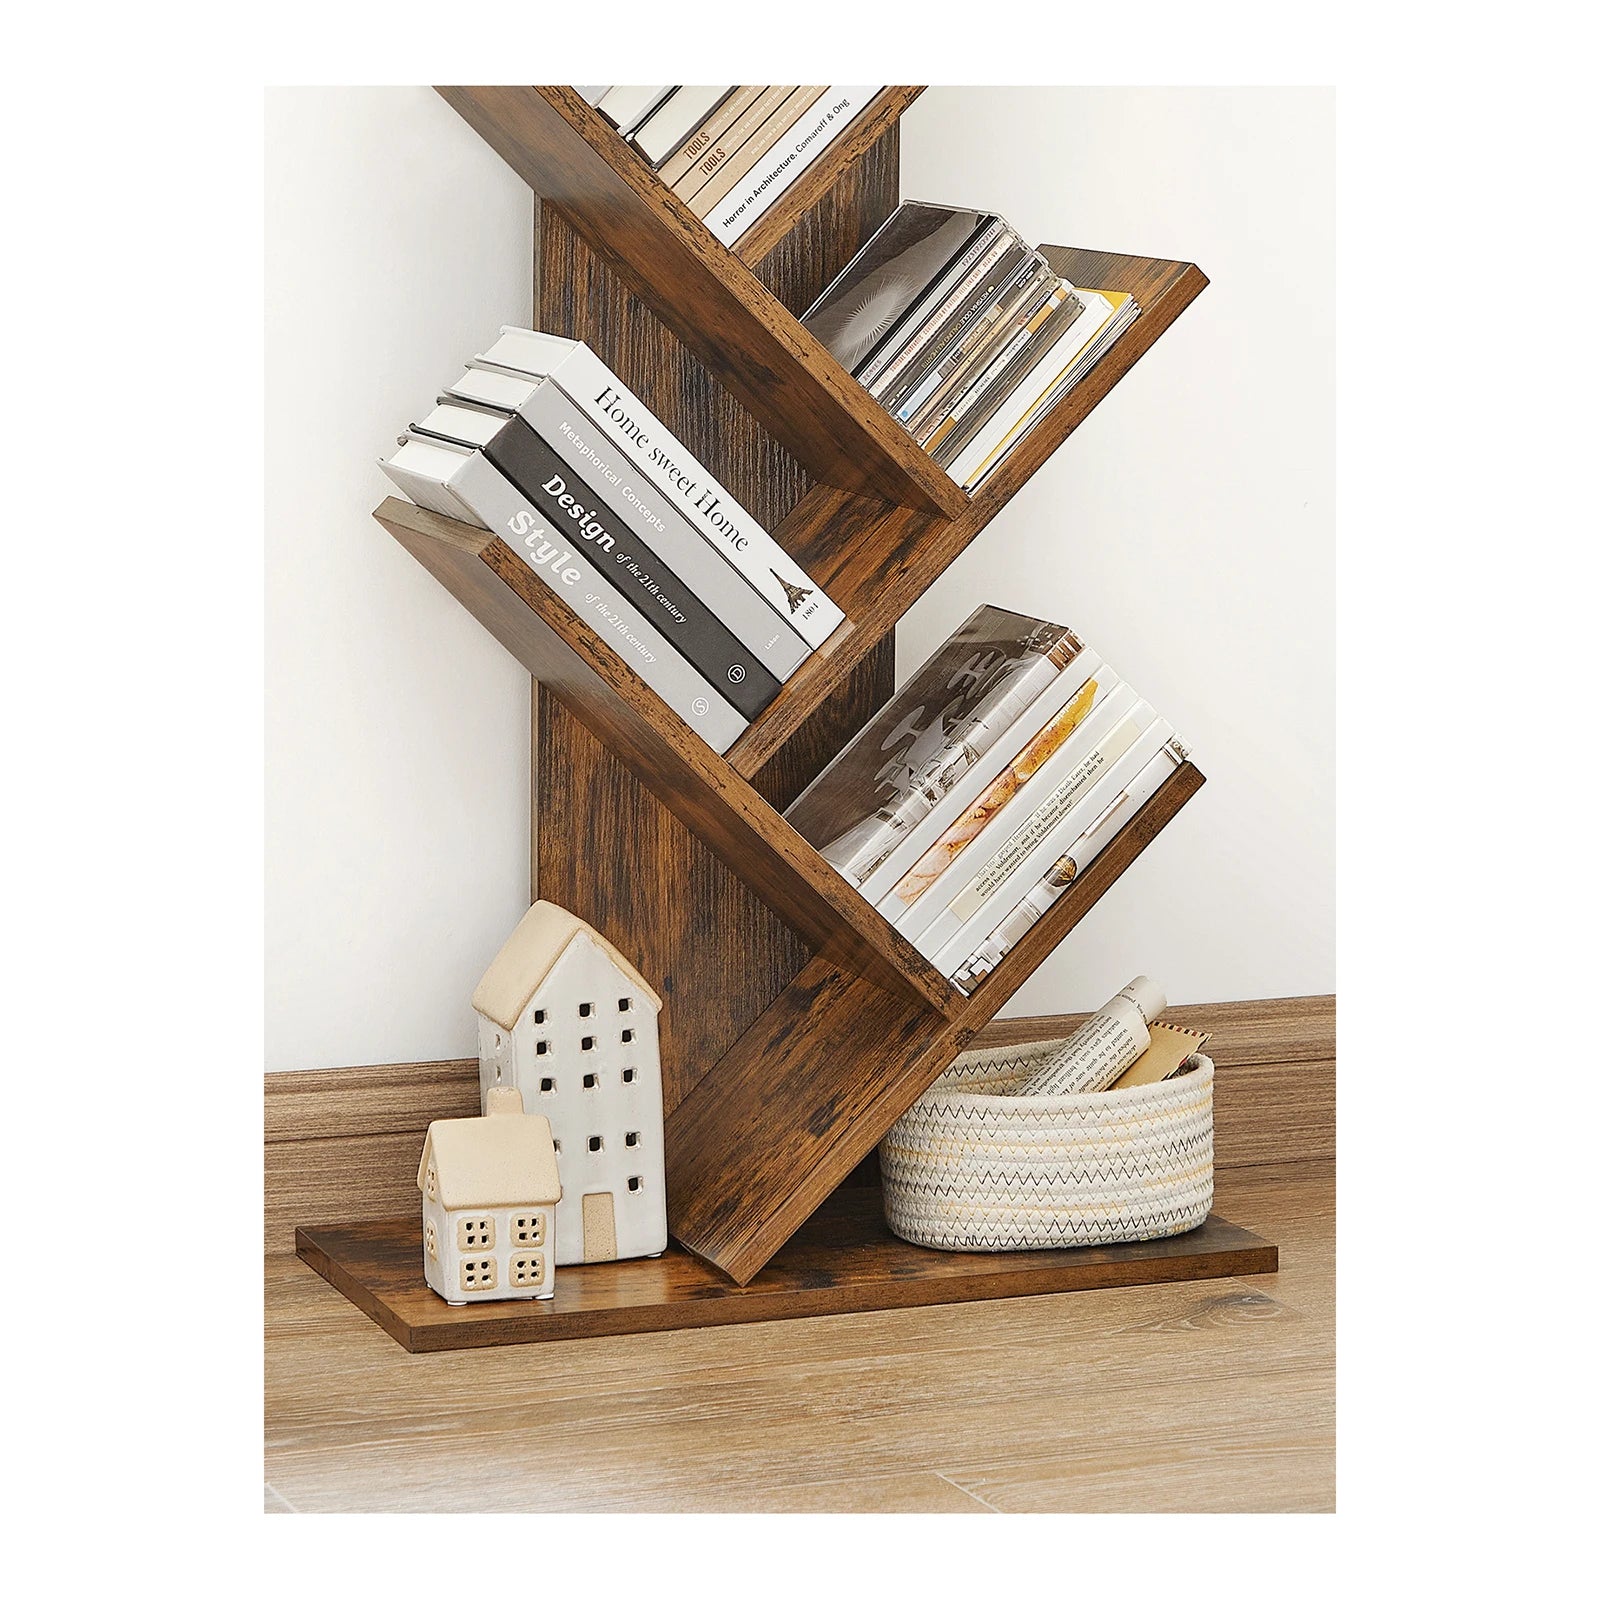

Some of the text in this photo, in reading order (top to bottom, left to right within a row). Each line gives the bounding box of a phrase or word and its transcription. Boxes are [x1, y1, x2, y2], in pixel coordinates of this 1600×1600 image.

[684, 132, 711, 160] TOOLS
[699, 148, 726, 177] TOOLS
[722, 99, 850, 228] Horror in Architecture. Comaroff & Ong
[559, 422, 665, 532] Metaphorical Concepts
[594, 386, 750, 552] Home sweet Home
[540, 473, 686, 623] Design of the 21th century
[507, 510, 656, 662] Style of the 21th century
[1090, 751, 1100, 761] had
[1021, 834, 1030, 845] and
[1041, 805, 1058, 822] became
[1059, 775, 1087, 805] disenchanted
[1087, 764, 1098, 776] then
[993, 872, 1005, 883] have
[1079, 1029, 1100, 1047] formerly
[1101, 1020, 1120, 1038] matches
[1111, 1028, 1128, 1046] wanted
[1071, 1047, 1082, 1056] had
[1090, 1038, 1102, 1050] gave
[1117, 1036, 1133, 1054] rubbed
[1079, 1050, 1090, 1061] such
[1086, 1058, 1097, 1071] quite
[1037, 1063, 1065, 1091] grandmother
[1057, 1065, 1077, 1084] brilliant
[1095, 1062, 1108, 1077] whole
[1046, 1083, 1059, 1096] light
[1069, 1082, 1075, 1090] of
[1078, 1077, 1094, 1094] bundle
